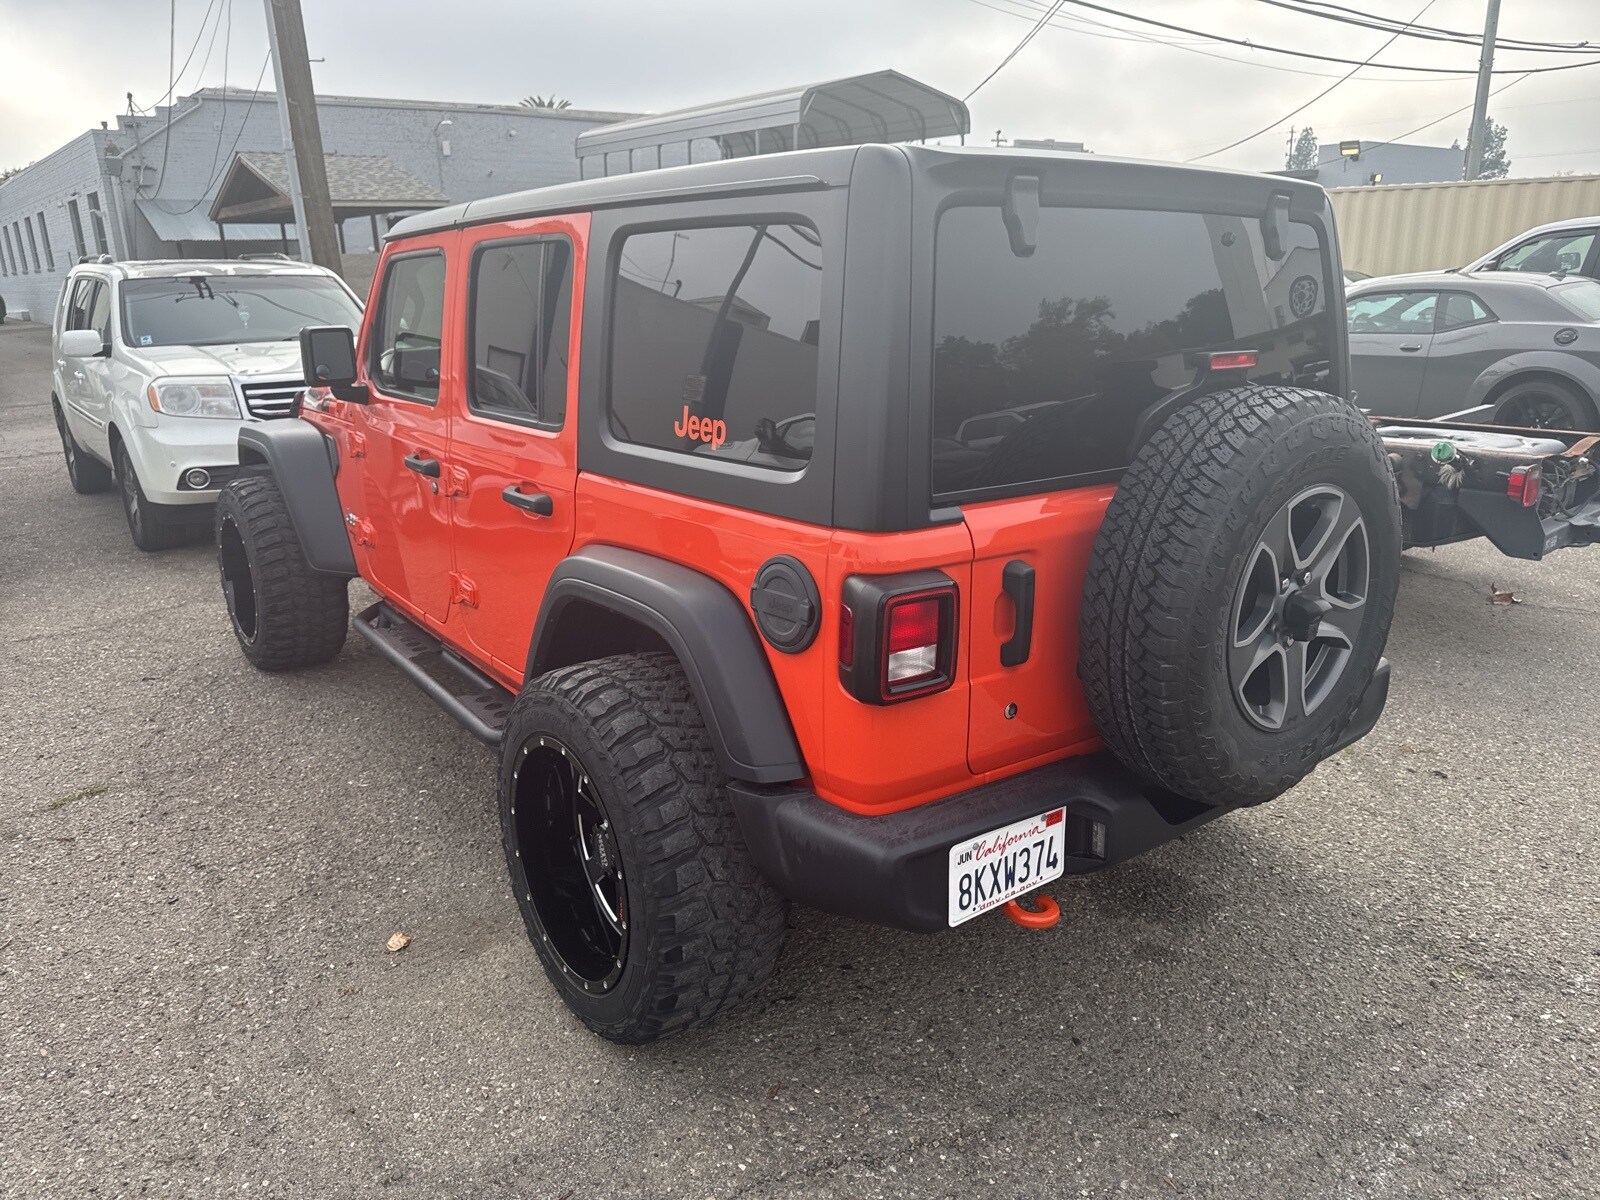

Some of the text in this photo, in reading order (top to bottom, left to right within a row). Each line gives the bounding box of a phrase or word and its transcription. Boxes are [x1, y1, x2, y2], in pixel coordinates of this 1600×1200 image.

[674, 405, 727, 451] Jeep
[957, 850, 972, 866] JUN
[975, 823, 1045, 861] California
[958, 835, 1059, 911] 8KXW374
[977, 880, 1039, 911] dmv.ca.gov
